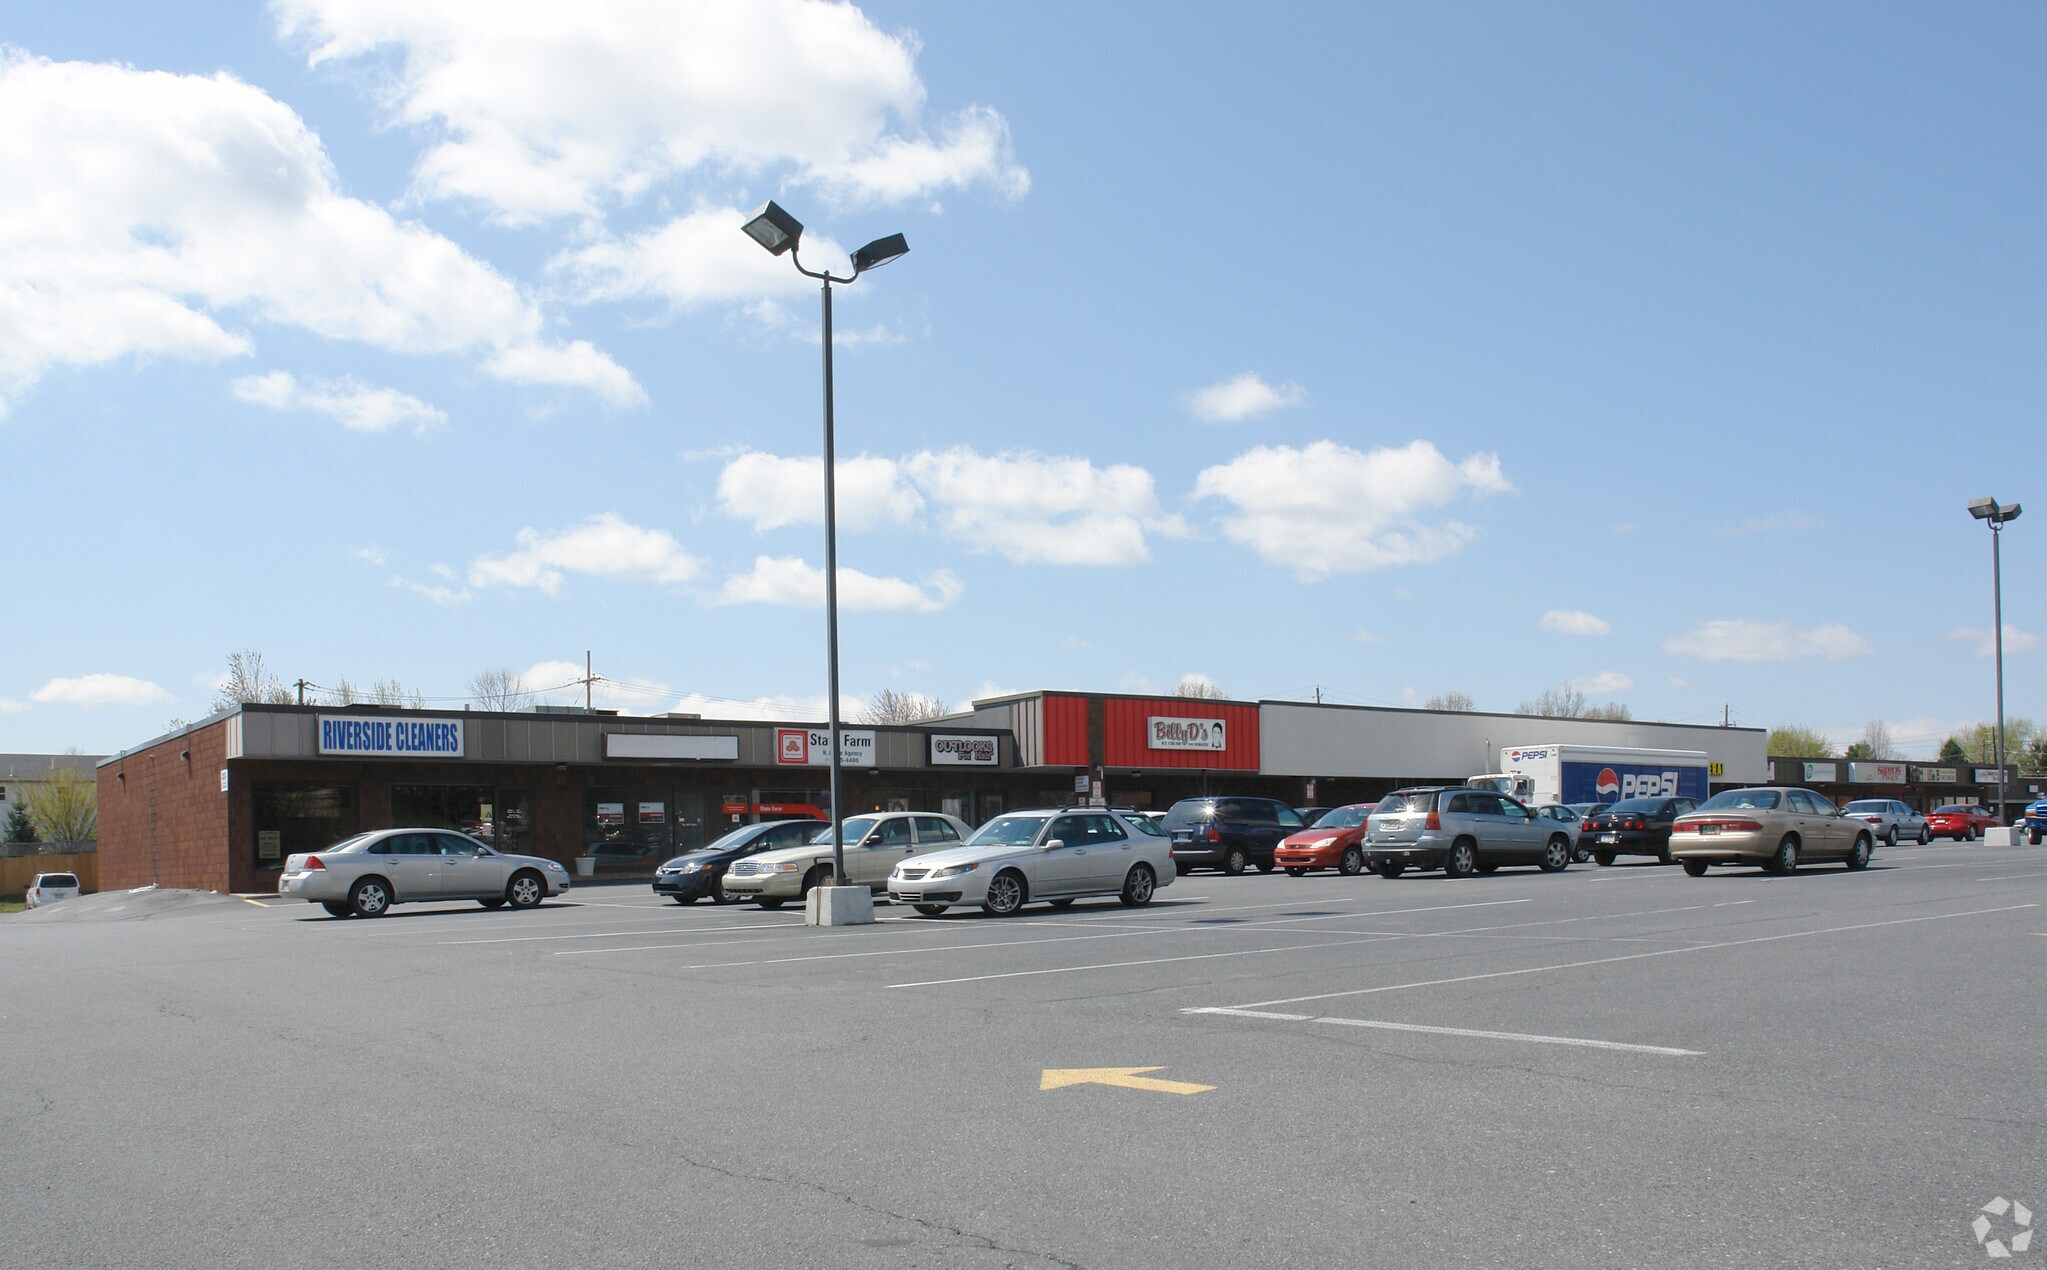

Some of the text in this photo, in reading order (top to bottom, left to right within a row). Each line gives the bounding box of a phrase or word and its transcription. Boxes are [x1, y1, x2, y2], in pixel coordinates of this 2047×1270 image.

[323, 720, 459, 752] RIVERSIDE CLEANERS
[810, 733, 871, 747] Sta Farm
[935, 740, 994, 752] OUTLOOKS
[1521, 750, 1548, 760] PEPSI
[1621, 771, 1679, 801] PEPSI
